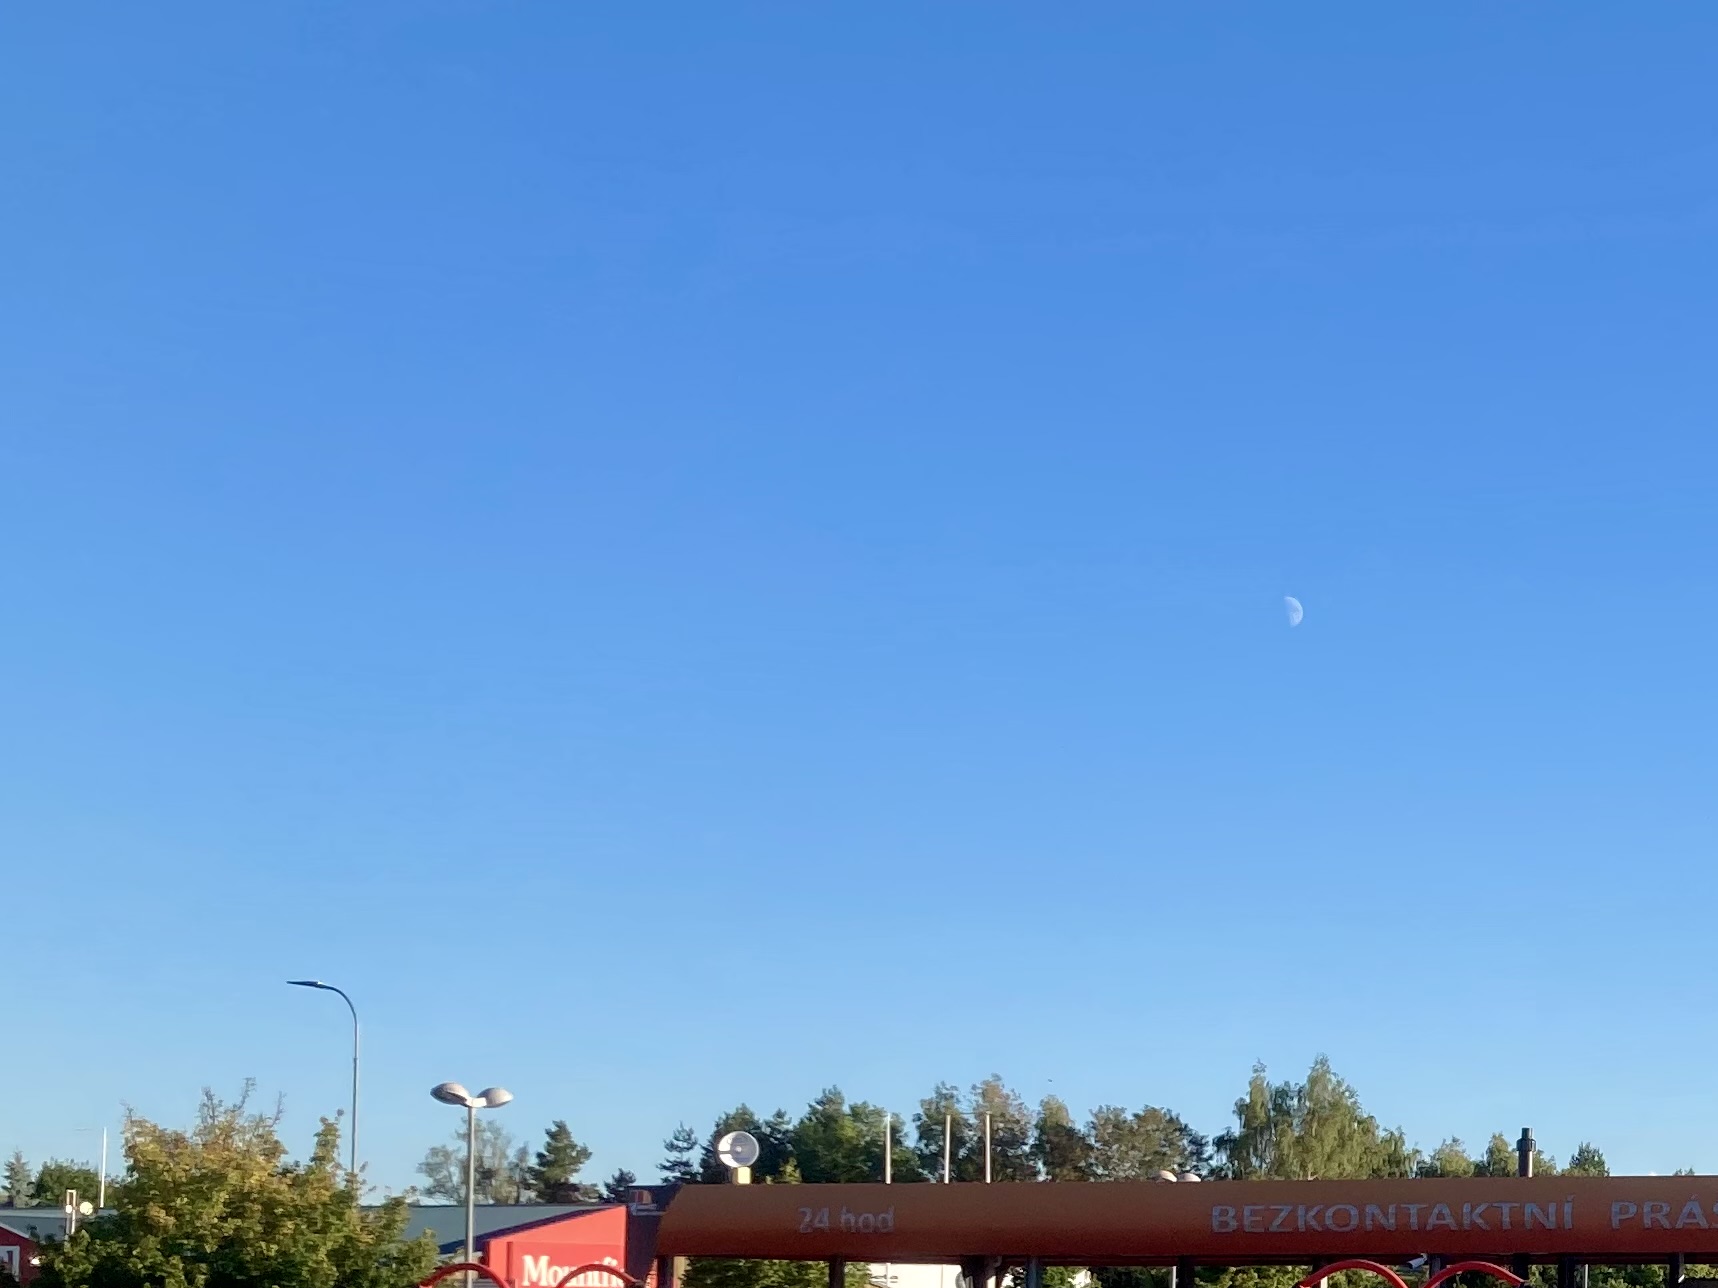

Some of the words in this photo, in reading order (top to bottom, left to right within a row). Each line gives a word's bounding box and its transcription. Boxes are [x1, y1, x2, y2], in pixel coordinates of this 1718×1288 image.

[798, 1206, 830, 1234] 24
[839, 1205, 895, 1233] hod
[1210, 1195, 1575, 1233] BEZKONTAKTNÍ
